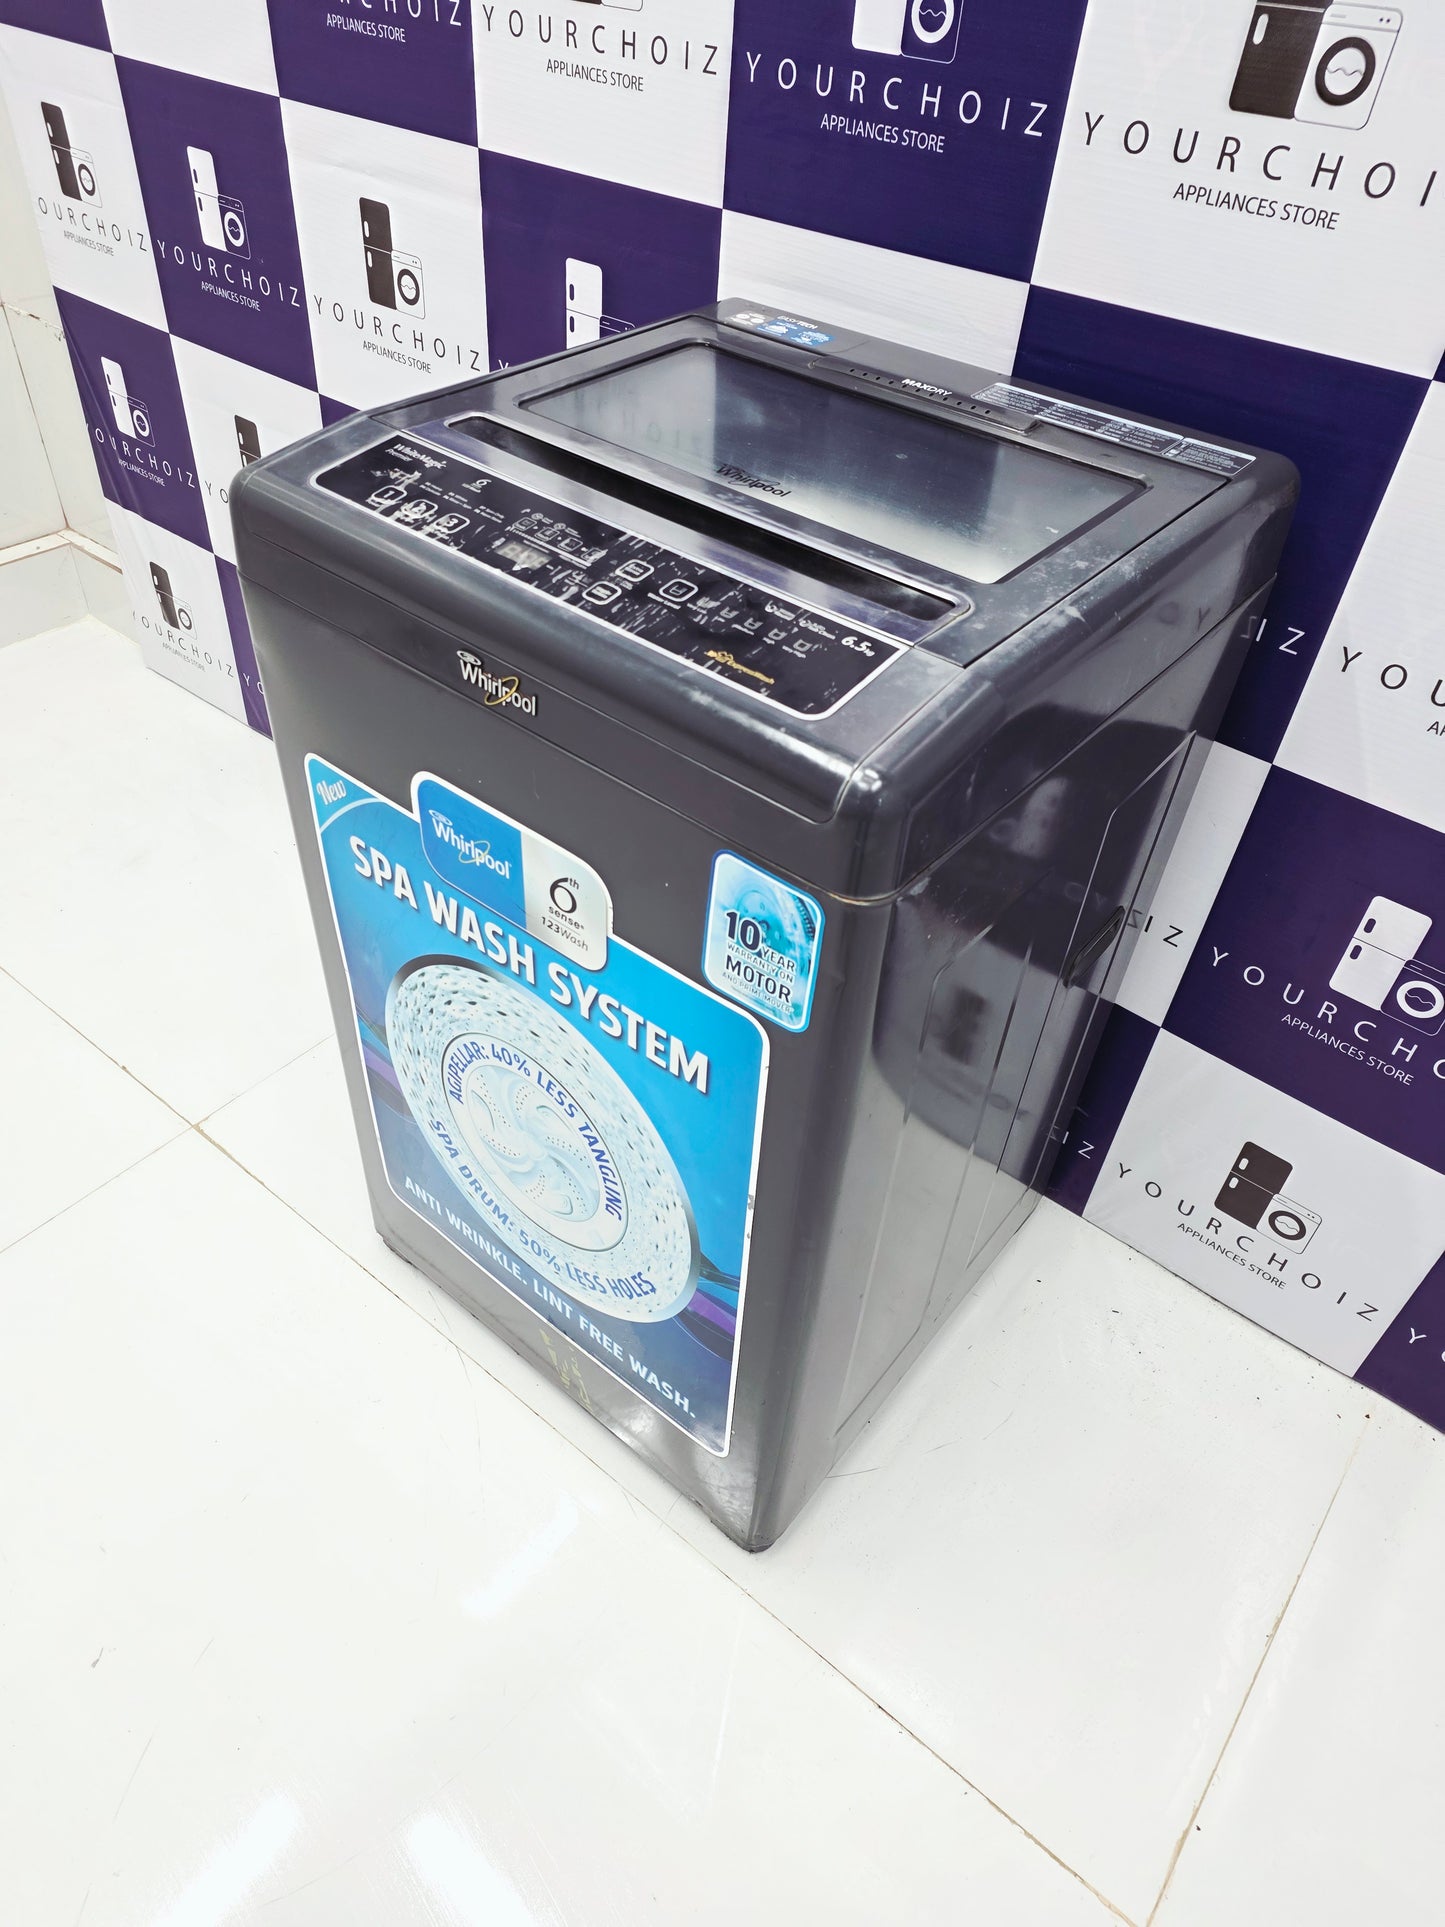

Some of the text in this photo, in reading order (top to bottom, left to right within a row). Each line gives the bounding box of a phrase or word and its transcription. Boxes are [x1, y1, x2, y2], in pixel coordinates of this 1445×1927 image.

[326, 13, 406, 42] APPLIANCES STORE
[484, 4, 718, 76] YOURCHOIZ
[546, 59, 644, 92] APPLIANCES STORE
[746, 52, 1048, 136] YOURCHOIZ
[820, 113, 945, 153] APPLIANCES STORE
[1084, 111, 1437, 206] YOURCHOI
[1173, 182, 1340, 231] APPLIANCES STORE
[157, 240, 300, 308] YOURCHOIZ
[201, 280, 260, 312] APPLIANCES STORE
[314, 295, 481, 372] YOURCHOIZ
[362, 340, 431, 374] APPLIANCES STORE
[901, 378, 952, 397] MAXDRY
[86, 422, 195, 488] OURCHOIZ
[717, 464, 792, 498] Whirlpool
[459, 657, 537, 717] Whirlpool
[317, 778, 348, 806] New
[432, 817, 510, 880] Whirlpool
[349, 835, 711, 1095] SPA WASH SYSTEM
[726, 911, 795, 972] 10 YEAR
[727, 942, 794, 983] WARRANTY ON
[722, 971, 738, 985] AND
[726, 955, 791, 1003] MOTOR
[1281, 1013, 1414, 1086] APPLIANCES STORE
[491, 1043, 532, 1078] 40%
[536, 1068, 579, 1121] LESS
[578, 1119, 623, 1221] TANGLING
[430, 1117, 657, 1299] SPA DRUM: 50% LESS HOLES
[1118, 1162, 1380, 1322] YOURCHOIZ
[1177, 1220, 1288, 1291] APPLIANCES STORE
[404, 1175, 697, 1419] ANTI WRINKLE. LINT FREE WASH.
